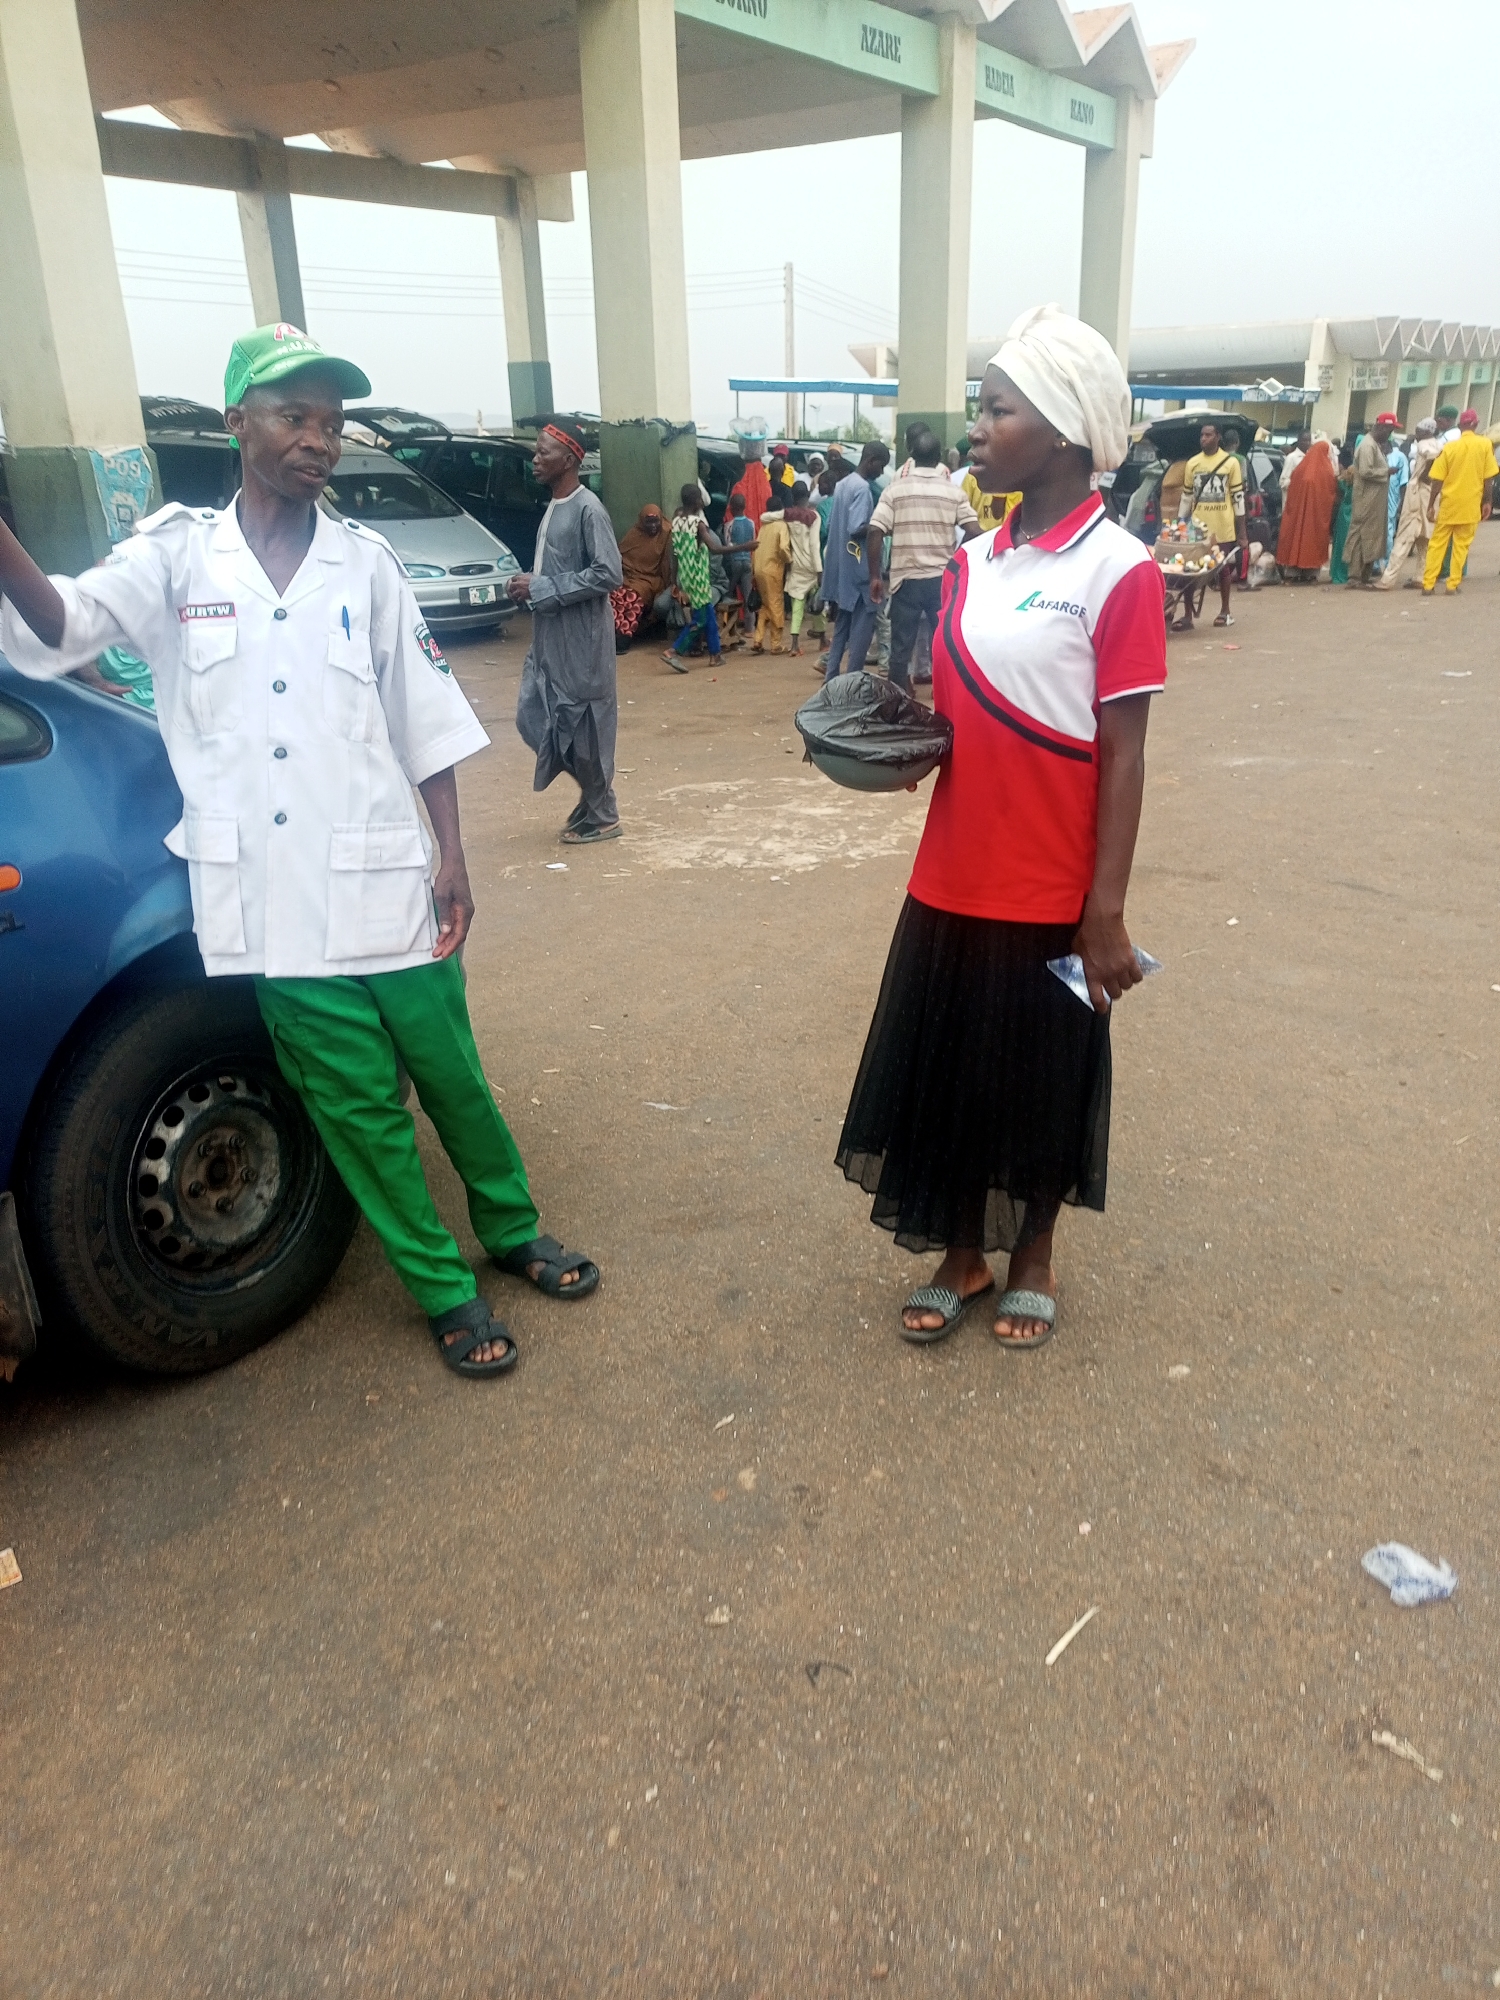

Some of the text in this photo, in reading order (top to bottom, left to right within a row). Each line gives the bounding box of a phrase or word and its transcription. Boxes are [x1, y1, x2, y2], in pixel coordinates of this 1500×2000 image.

[861, 24, 901, 64] AZARE
[1070, 98, 1095, 126] KANO
[1029, 597, 1087, 618] LAFARGE
